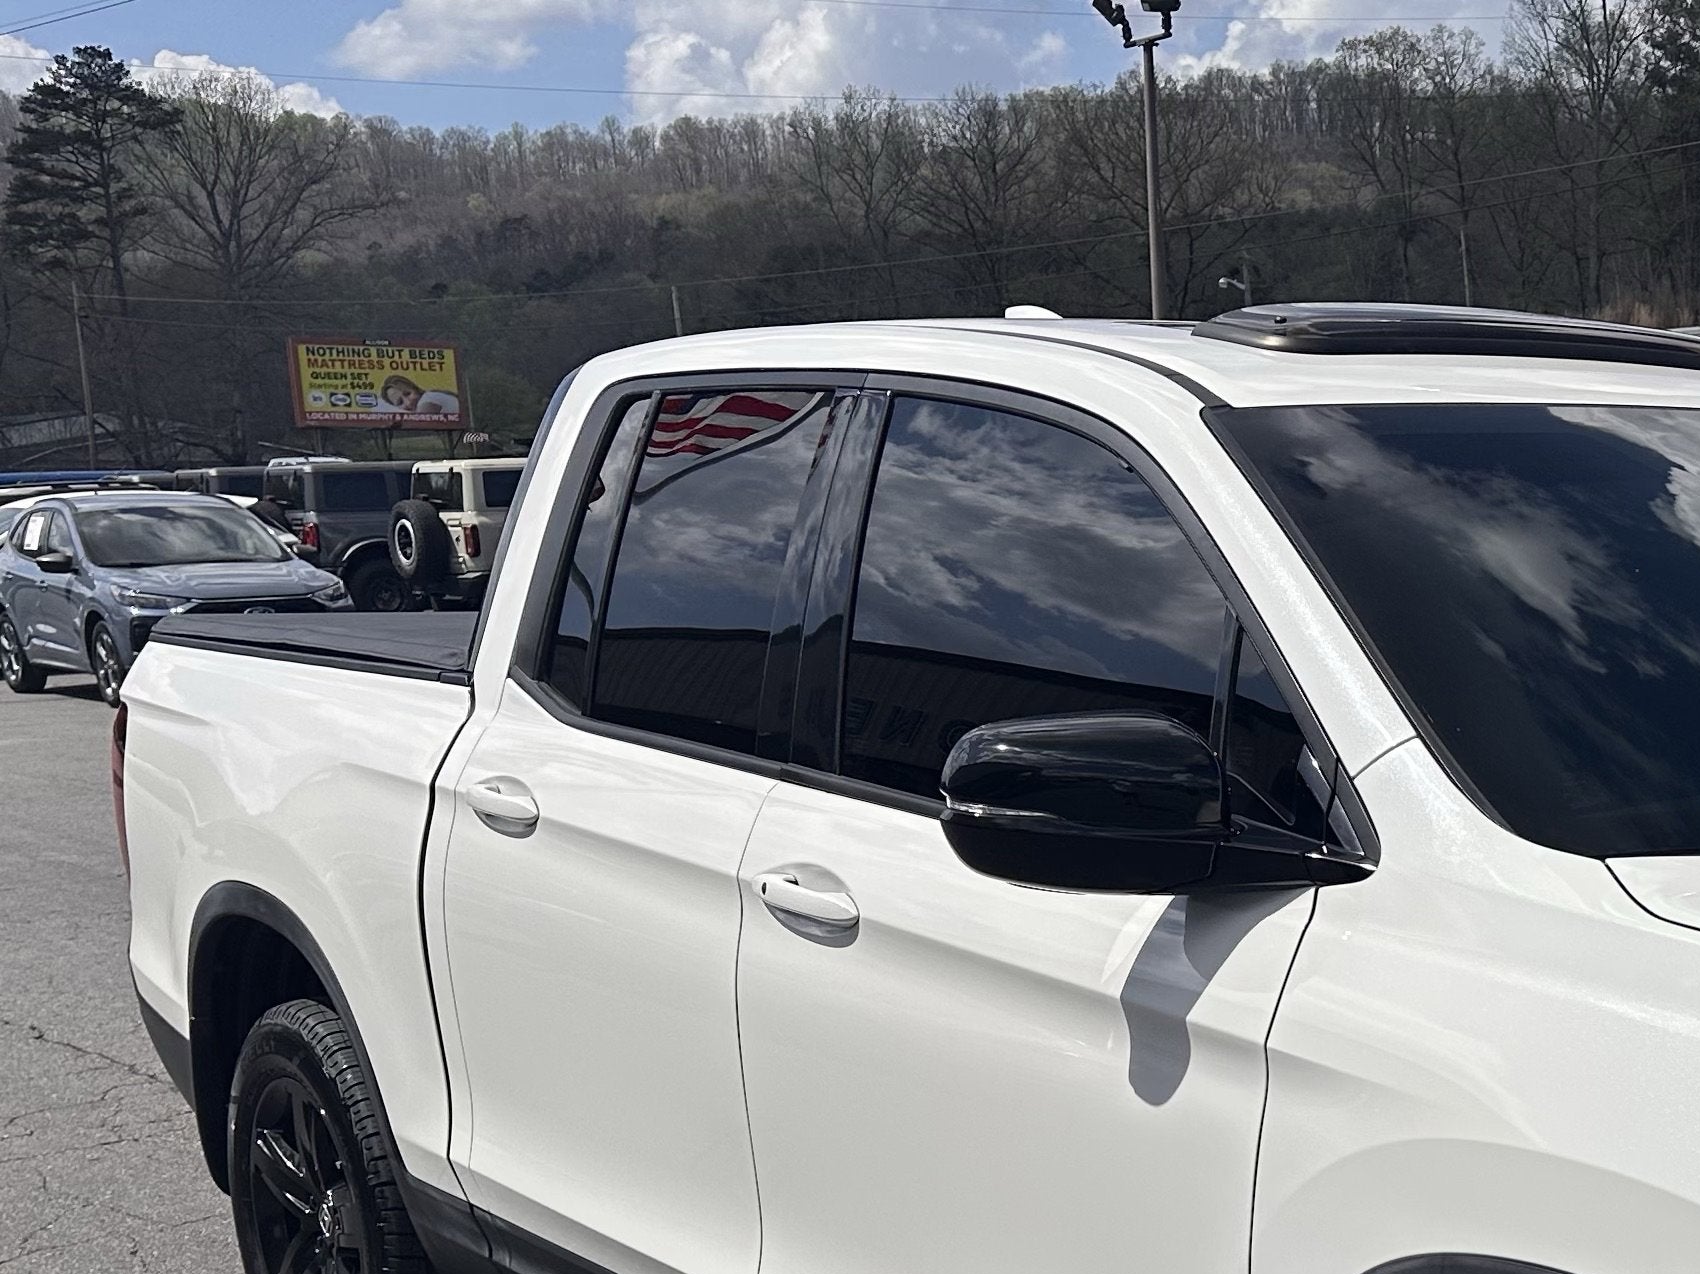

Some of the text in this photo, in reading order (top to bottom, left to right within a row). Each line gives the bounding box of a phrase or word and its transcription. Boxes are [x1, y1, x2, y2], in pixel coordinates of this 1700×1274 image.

[305, 346, 445, 360] NOTHING BUT BEDS
[307, 358, 445, 372] MATTRESS OUTLET
[310, 371, 369, 381] QUEEN SET
[350, 381, 375, 390] $499
[305, 412, 347, 420] LOCATED
[358, 413, 394, 421] MURPHY
[447, 414, 460, 422] NC
